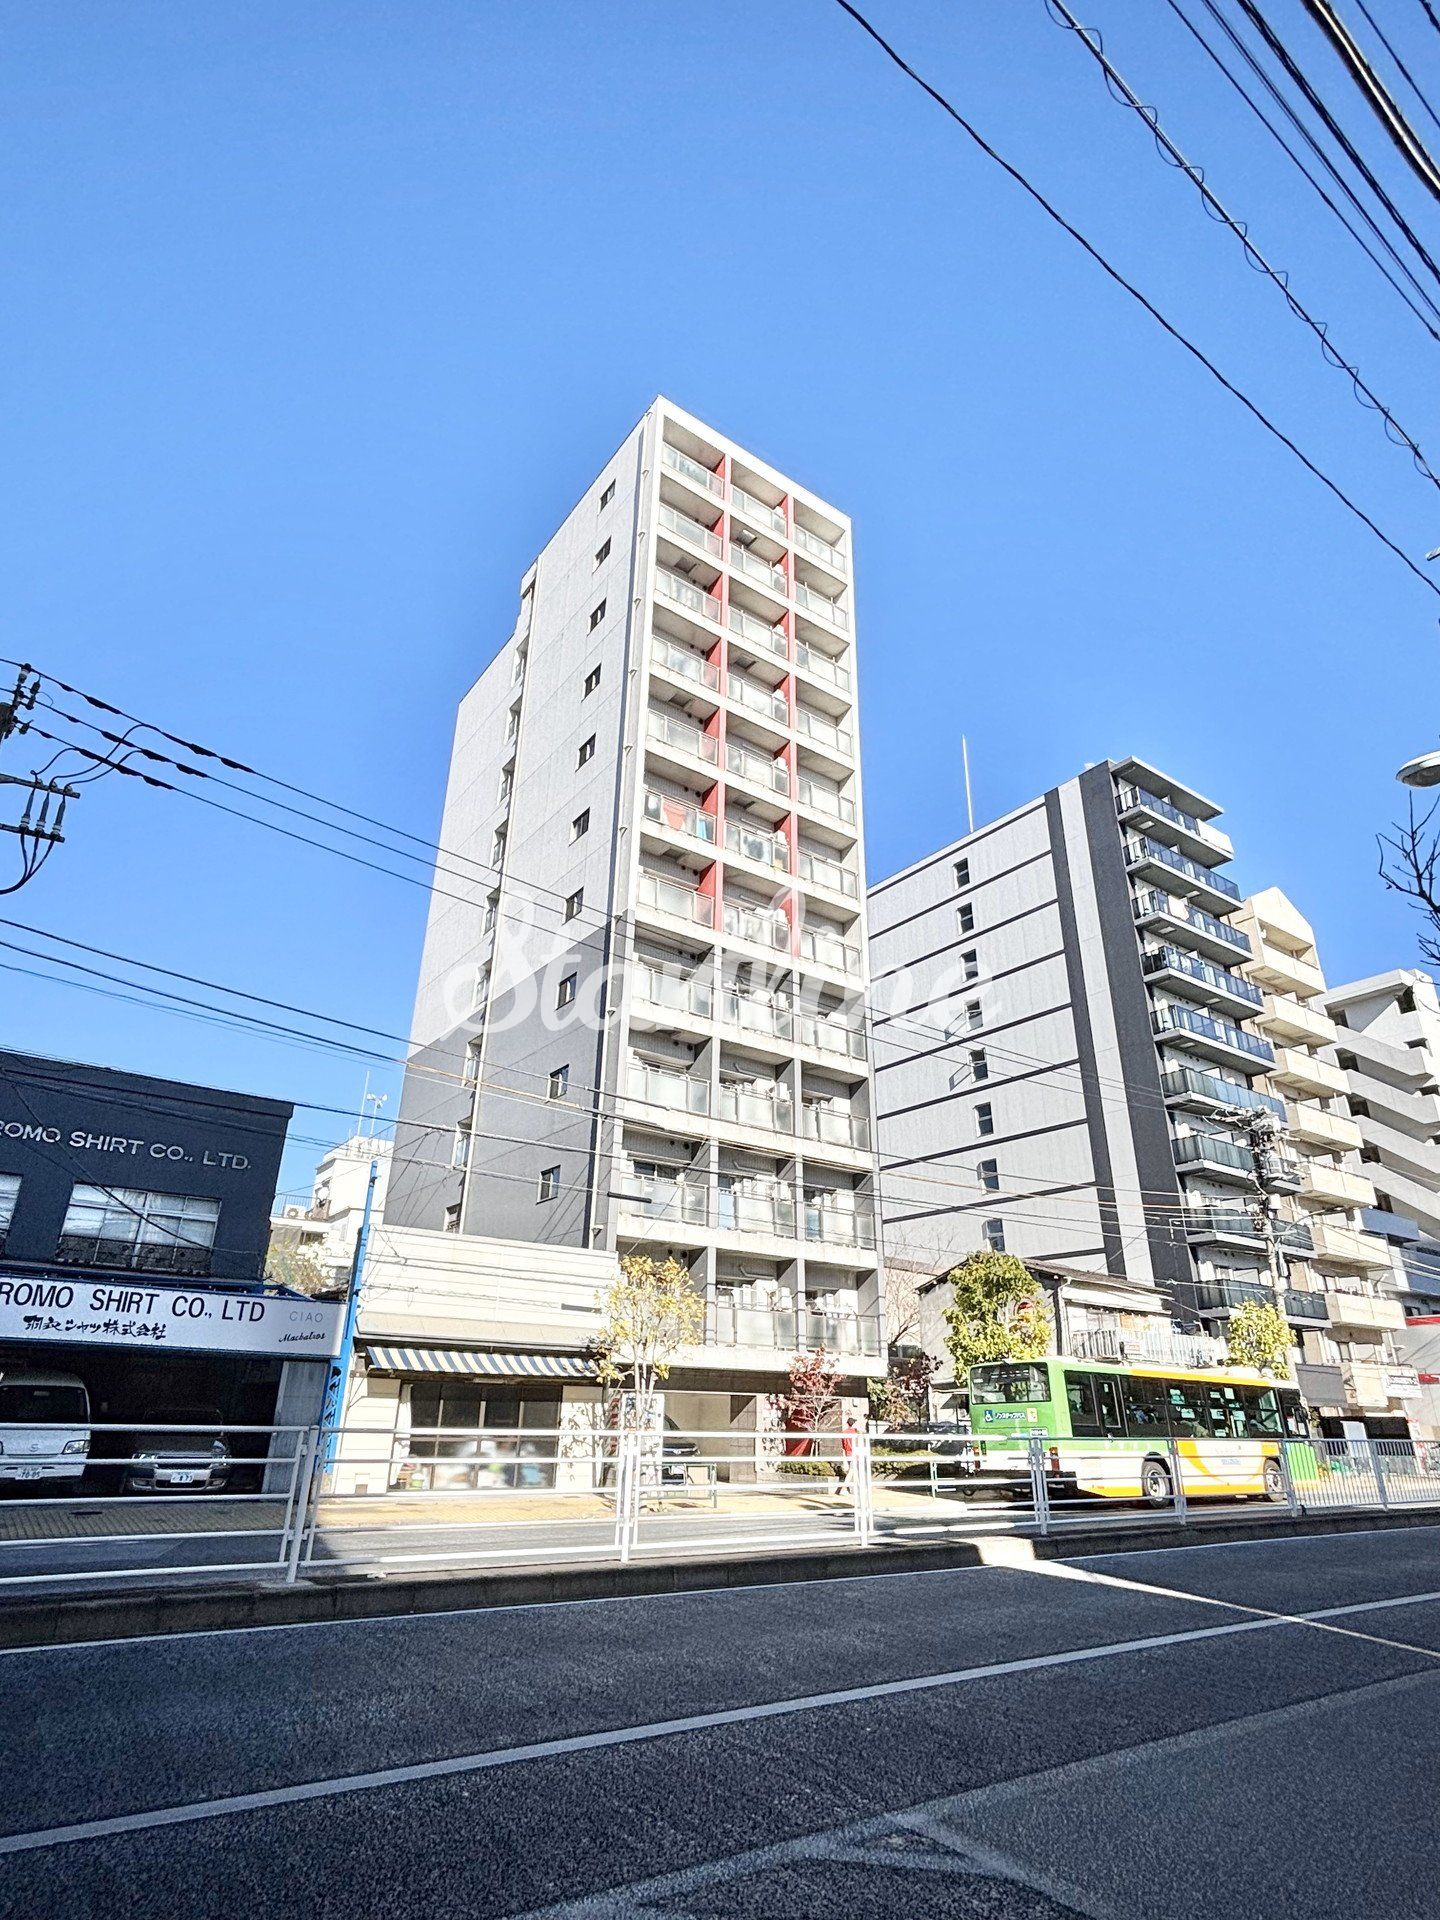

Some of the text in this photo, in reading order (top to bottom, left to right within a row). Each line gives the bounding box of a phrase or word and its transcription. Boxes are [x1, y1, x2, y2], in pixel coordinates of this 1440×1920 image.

[69, 1131, 145, 1155] SHIRT
[89, 1288, 160, 1315] SHIRT
[221, 1299, 266, 1323] LTD
[289, 1310, 324, 1323] CIAO
